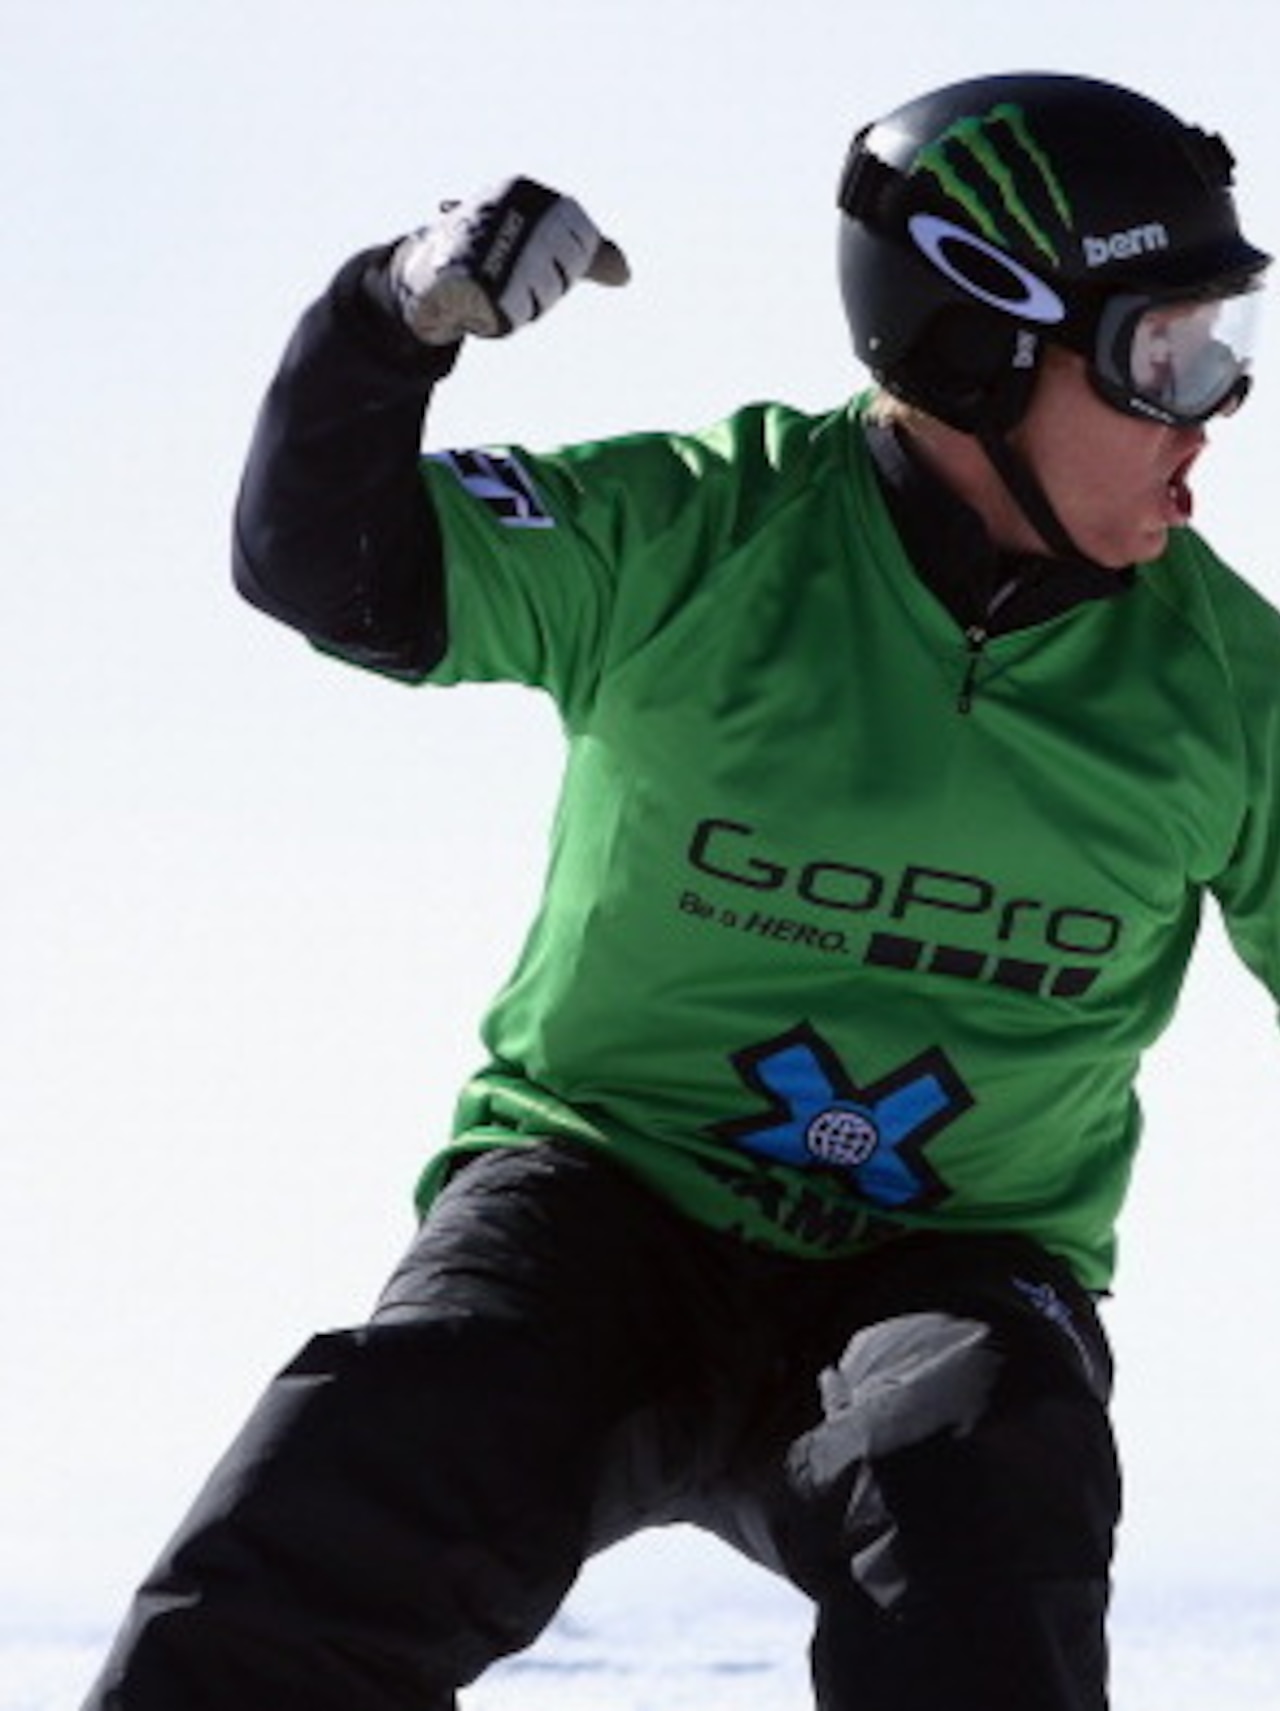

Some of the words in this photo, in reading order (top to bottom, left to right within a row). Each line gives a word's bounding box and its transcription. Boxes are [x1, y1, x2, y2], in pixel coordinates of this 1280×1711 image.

[1081, 222, 1169, 268] bern
[687, 817, 1122, 956] GoPro
[743, 910, 850, 955] HERO.
